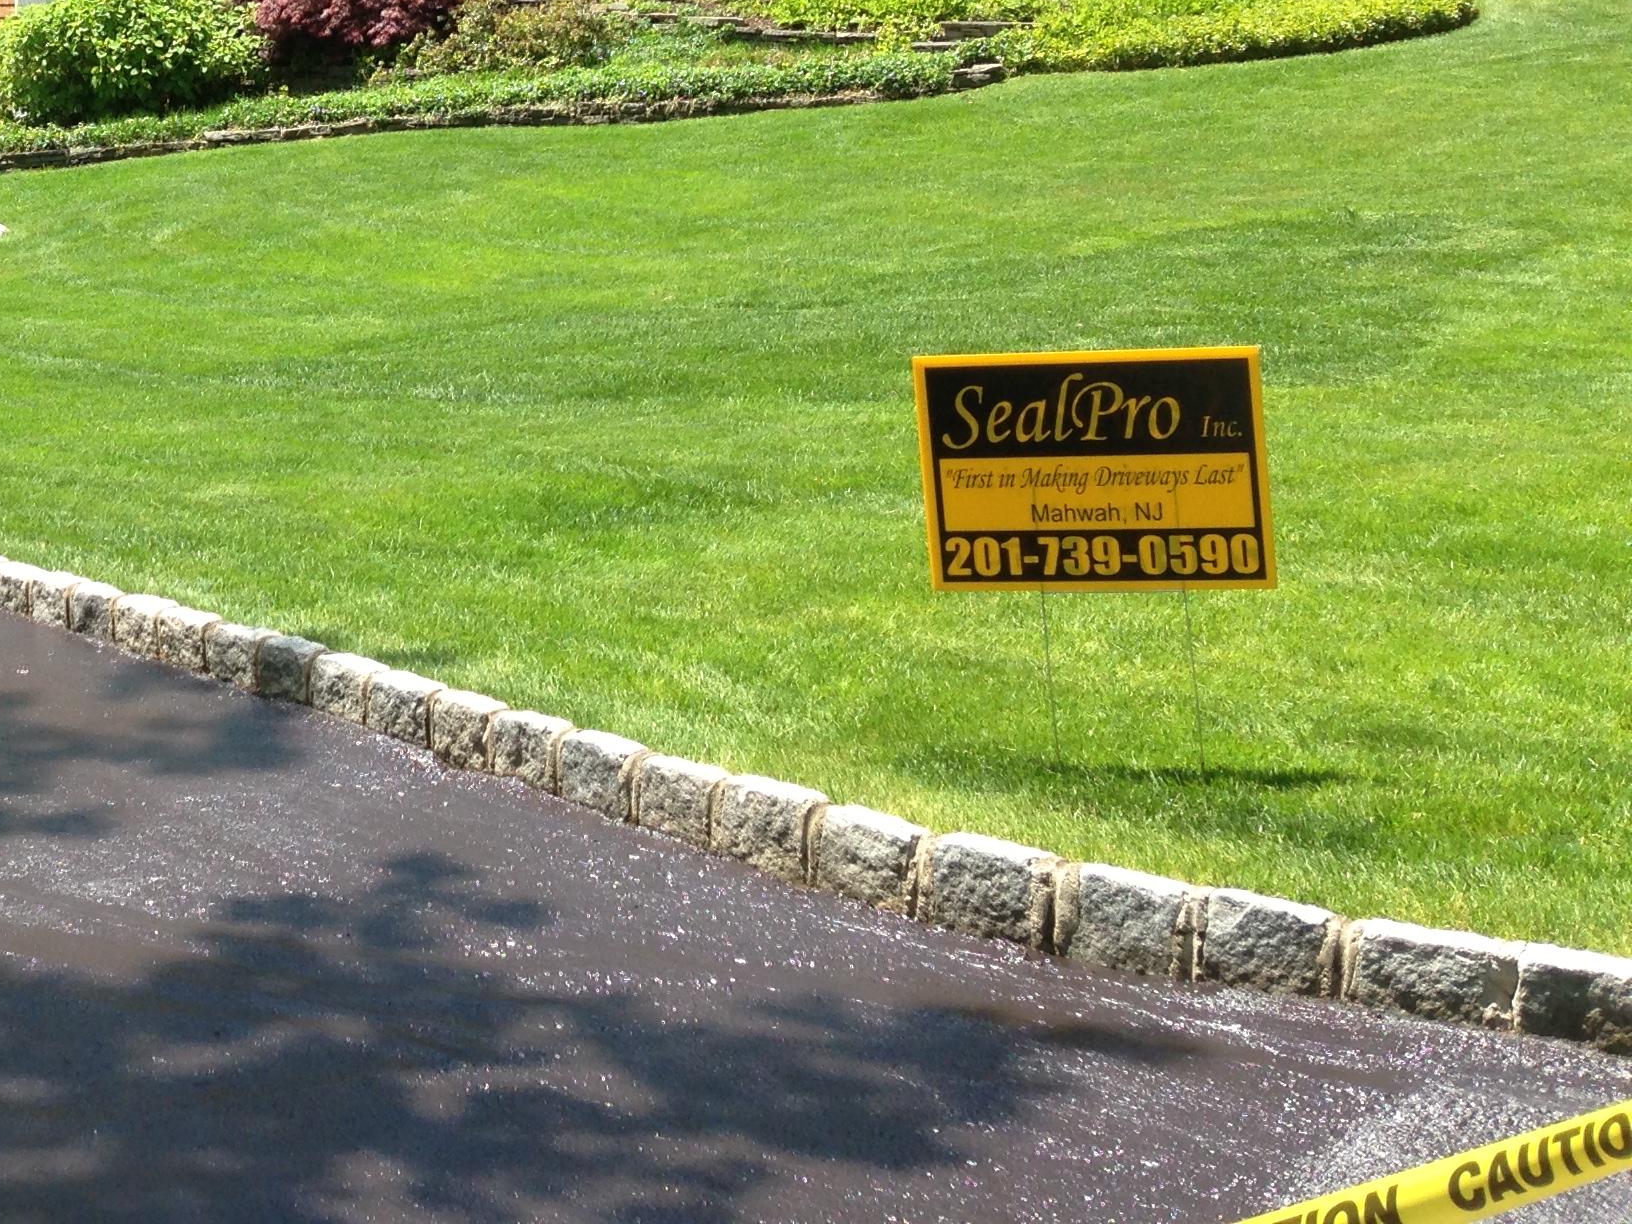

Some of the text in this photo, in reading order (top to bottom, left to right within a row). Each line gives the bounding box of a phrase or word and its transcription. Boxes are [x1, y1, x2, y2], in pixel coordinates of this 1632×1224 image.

[942, 373, 1243, 449] SealPro Inc.
[998, 467, 1016, 488] in
[1020, 464, 1089, 495] Making
[1094, 464, 1189, 493] Driveways
[1030, 502, 1163, 524] Mahwah, NJ
[944, 533, 1260, 577] 201-739-0590
